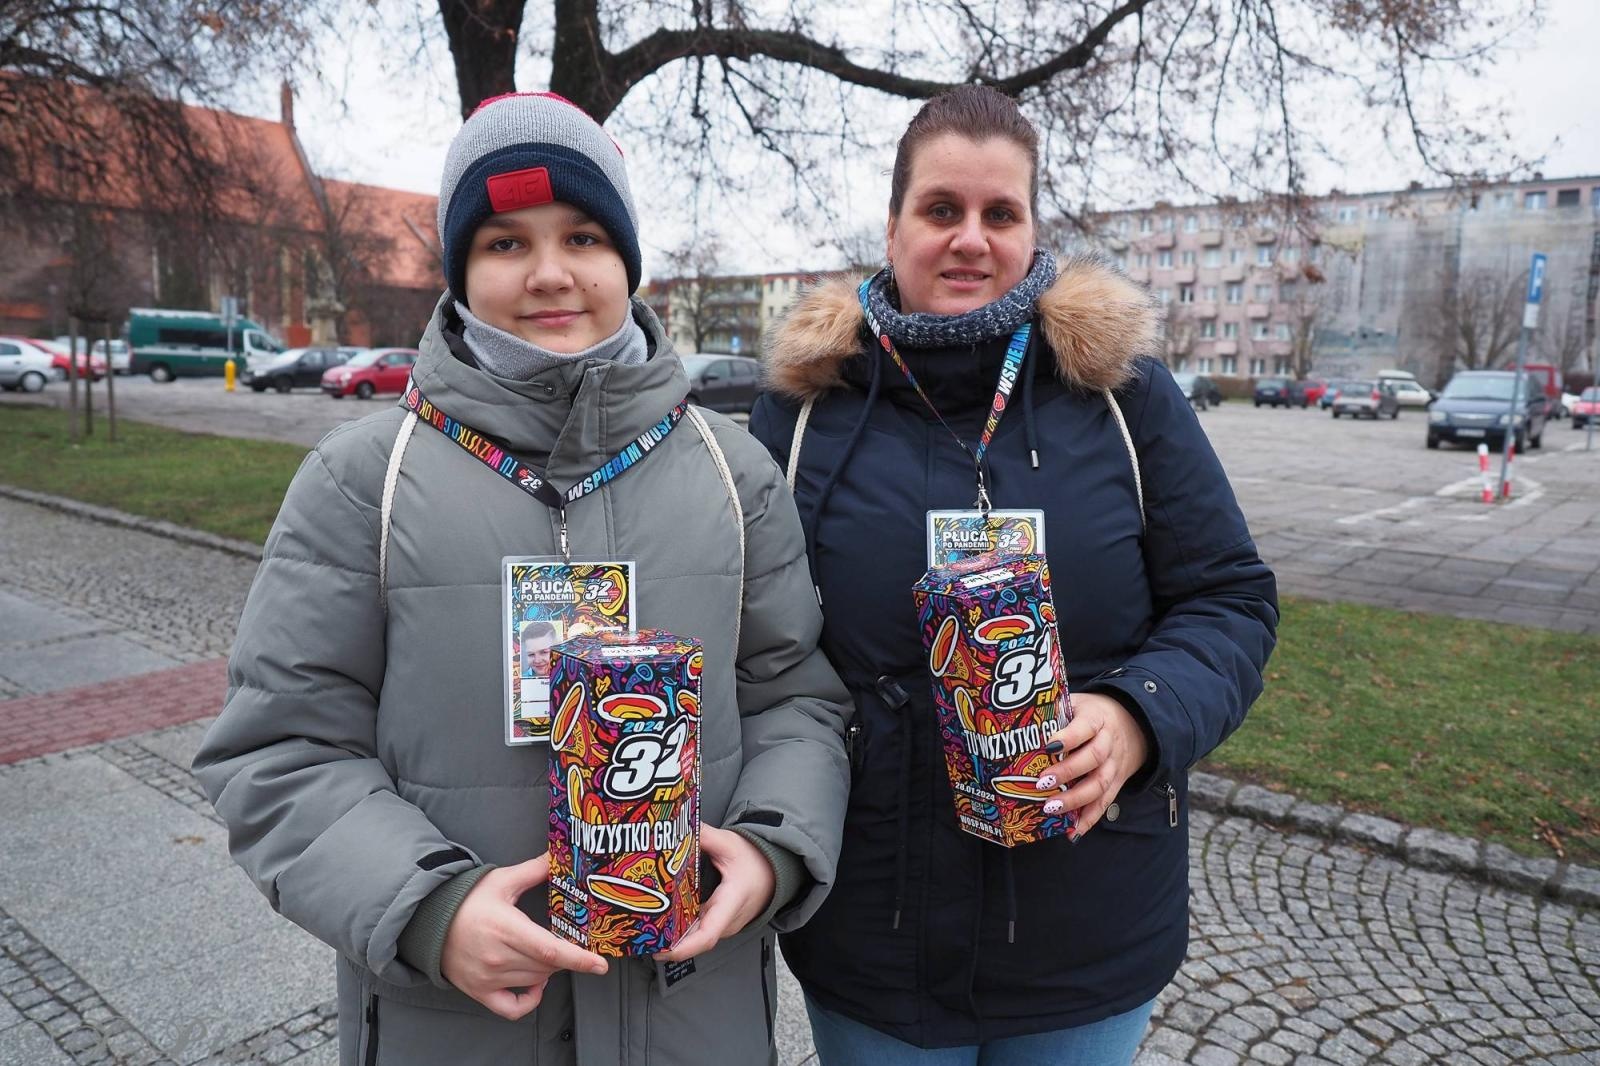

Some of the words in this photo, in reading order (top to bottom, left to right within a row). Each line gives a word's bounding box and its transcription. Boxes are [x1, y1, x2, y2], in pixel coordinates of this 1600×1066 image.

[433, 408, 452, 434] GRA
[452, 422, 504, 469] WSZYSTKO
[499, 456, 519, 478] TU
[568, 442, 643, 501] WSPIERAM
[520, 475, 542, 489] 32
[942, 530, 989, 542] PŁUCA
[942, 541, 953, 549] PO
[953, 540, 990, 549] PANDEMII
[998, 530, 1024, 548] 32
[521, 580, 574, 594] PŁUCA
[521, 593, 533, 601] PO
[534, 593, 575, 601] PANDEMII
[584, 580, 613, 601] 32
[1000, 634, 1035, 651] 2024
[995, 627, 1056, 705] 32
[622, 720, 665, 733] 2024
[963, 729, 978, 755] TU
[976, 724, 1041, 760] WSZYSTKO
[606, 718, 688, 796] 32
[954, 782, 996, 802] 28.01.2024
[569, 814, 582, 848] TU
[580, 821, 650, 854] WSZYSTKO
[551, 875, 588, 902] 28.01.2024
